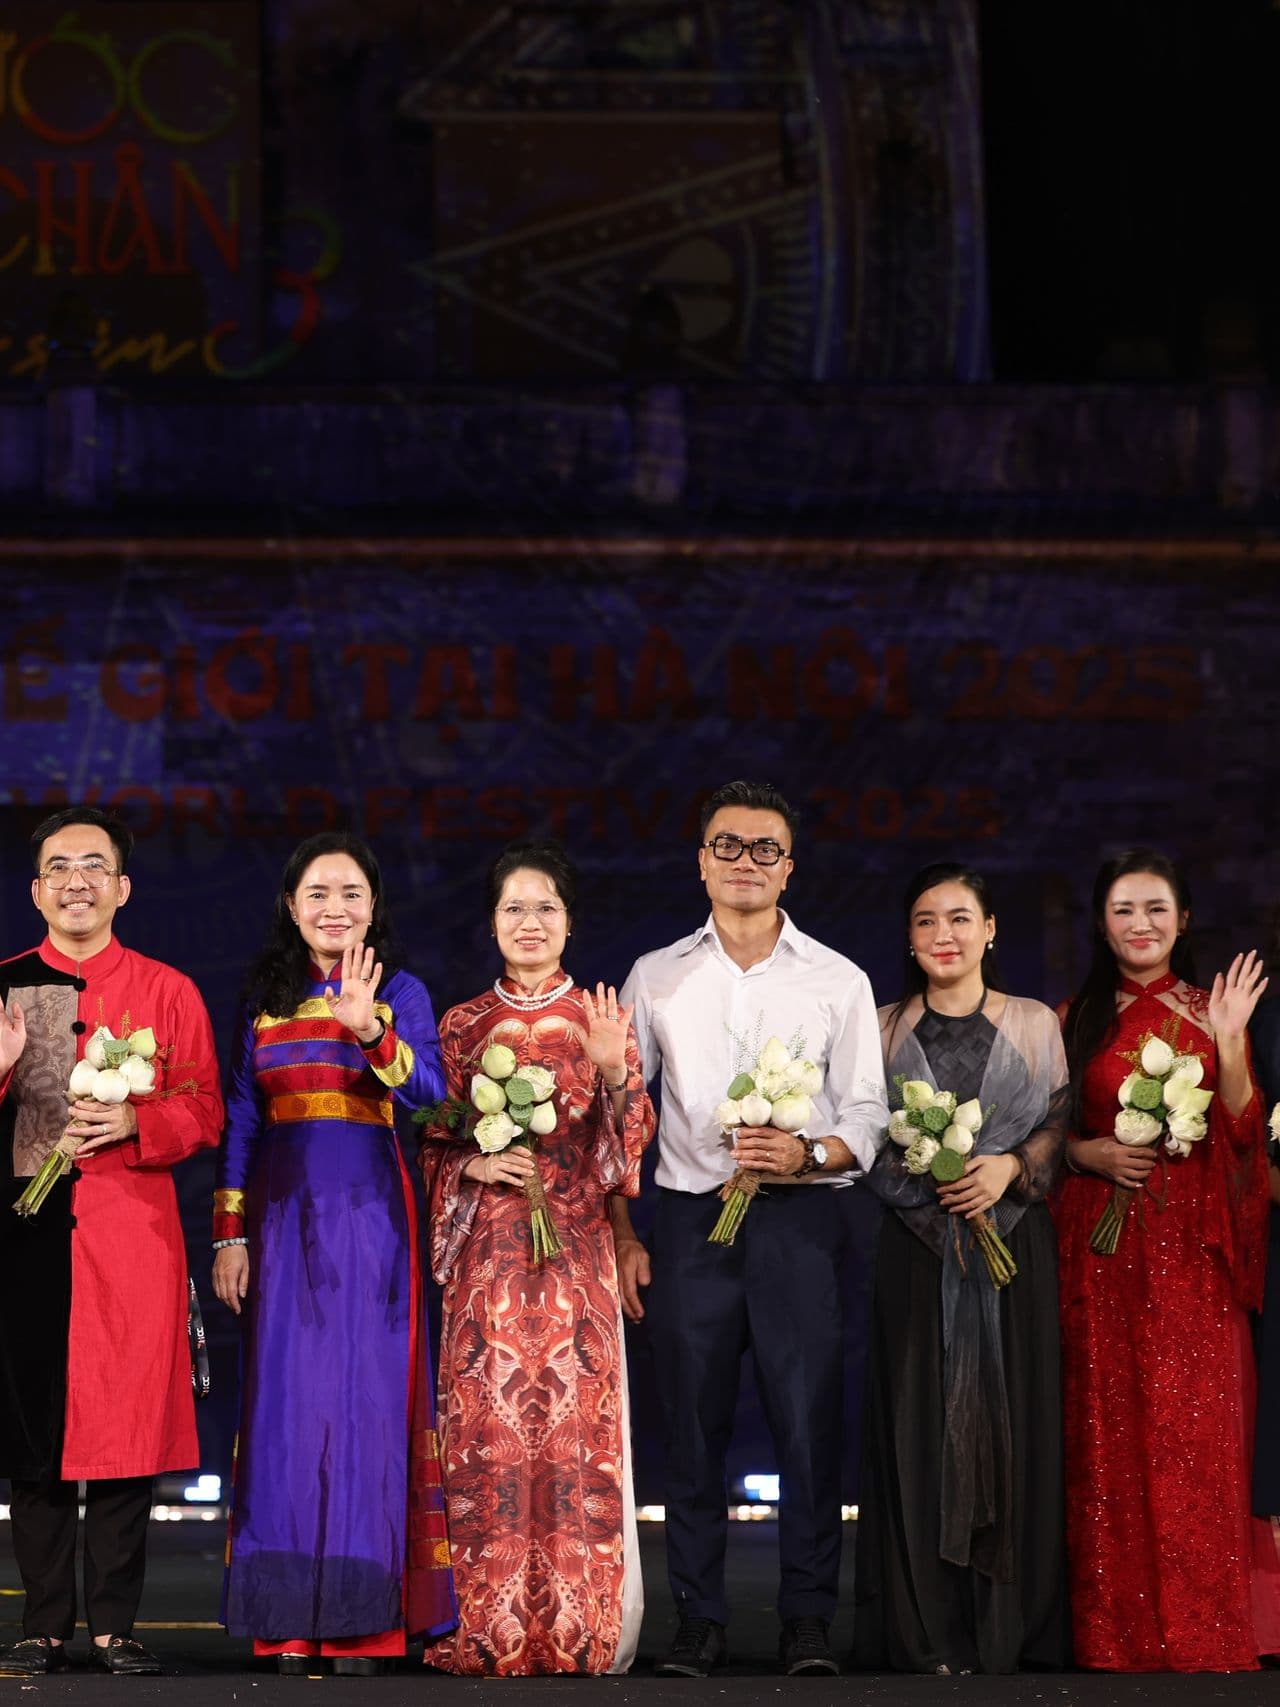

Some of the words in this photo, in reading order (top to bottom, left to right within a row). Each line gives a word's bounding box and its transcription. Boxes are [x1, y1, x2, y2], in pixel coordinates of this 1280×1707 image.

[102, 626, 313, 722] GIỚI
[343, 643, 519, 744] TẠI
[727, 626, 912, 744] NỘI
[942, 643, 1205, 722] 2025
[813, 788, 1004, 840] 2025
